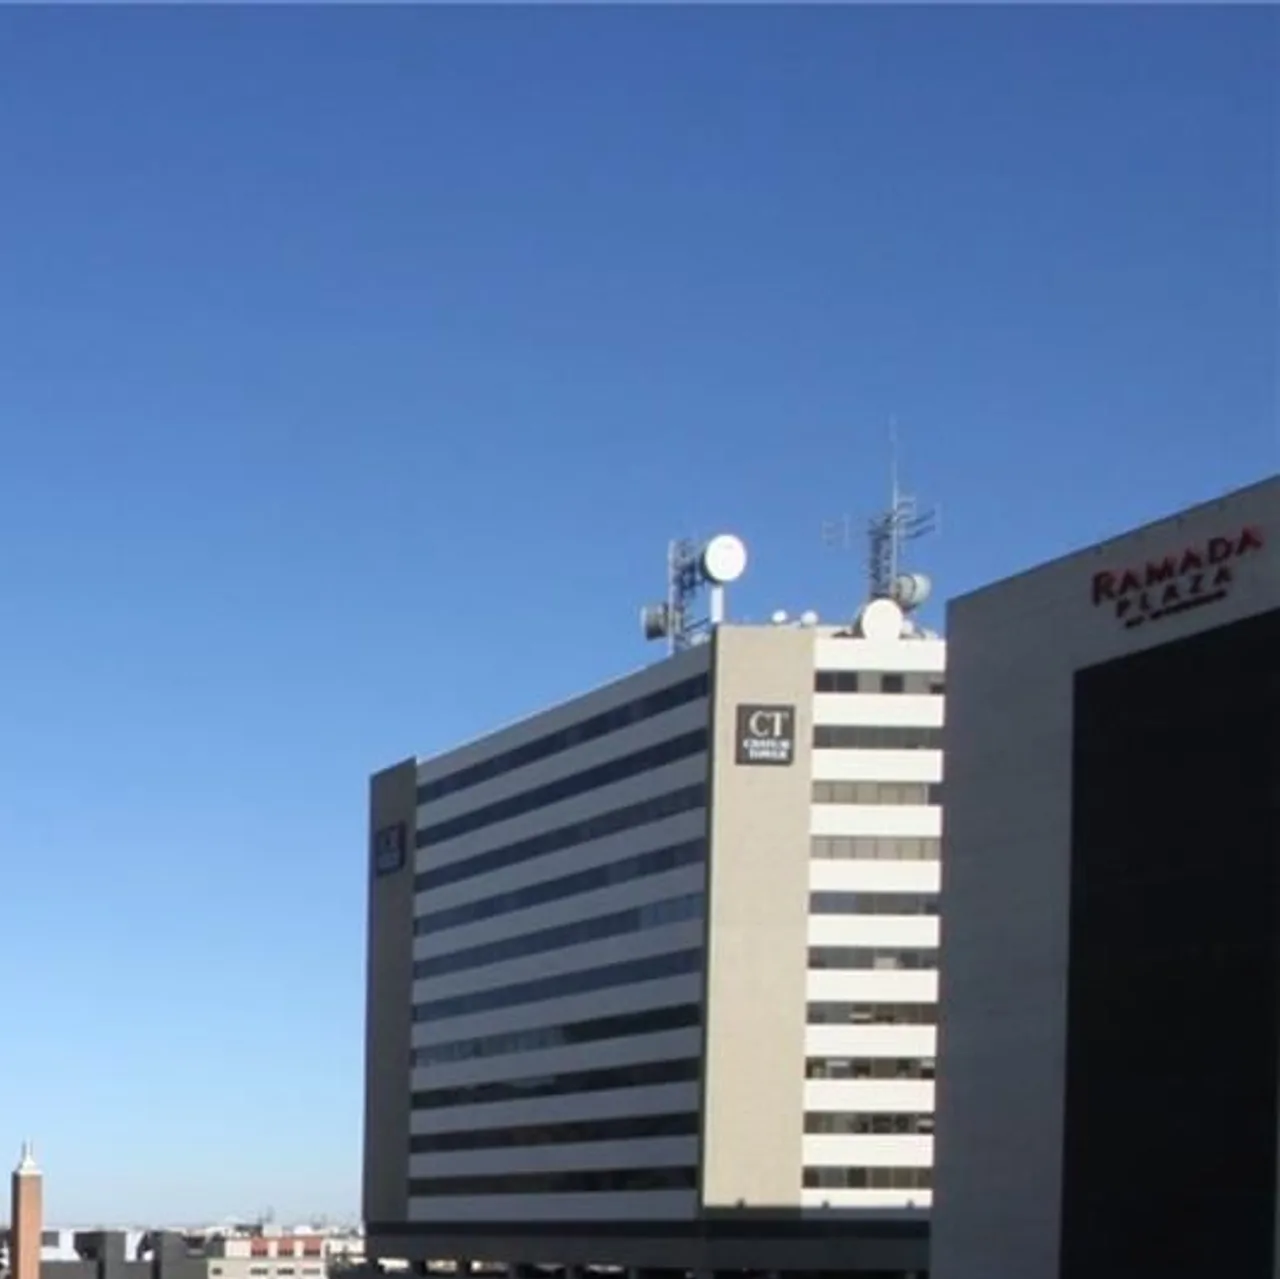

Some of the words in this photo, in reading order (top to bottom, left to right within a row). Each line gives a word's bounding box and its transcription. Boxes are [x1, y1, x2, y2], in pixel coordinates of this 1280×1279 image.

[1091, 526, 1264, 608] RAMADA
[1115, 565, 1233, 619] PLAZA
[749, 710, 790, 738] CT
